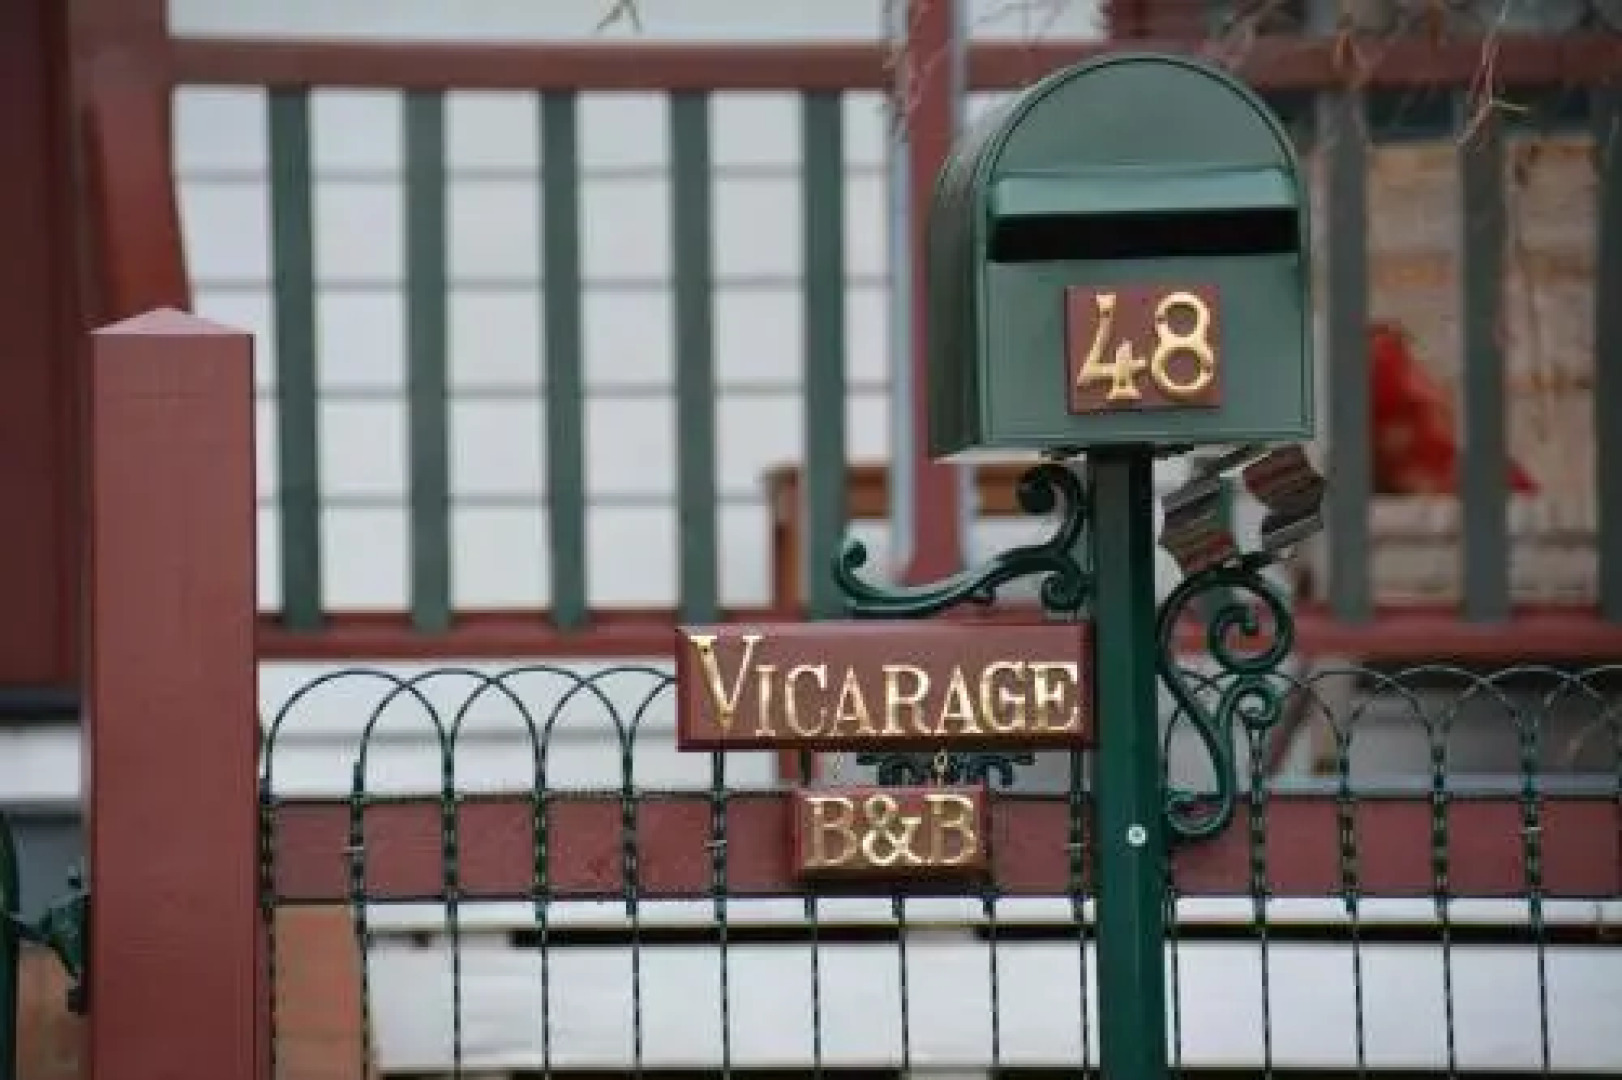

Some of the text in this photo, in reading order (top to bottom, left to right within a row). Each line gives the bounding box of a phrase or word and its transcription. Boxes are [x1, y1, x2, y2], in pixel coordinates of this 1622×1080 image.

[1076, 292, 1214, 401] 48
[689, 635, 1080, 737] VICARAGE
[805, 794, 977, 868] B&B
